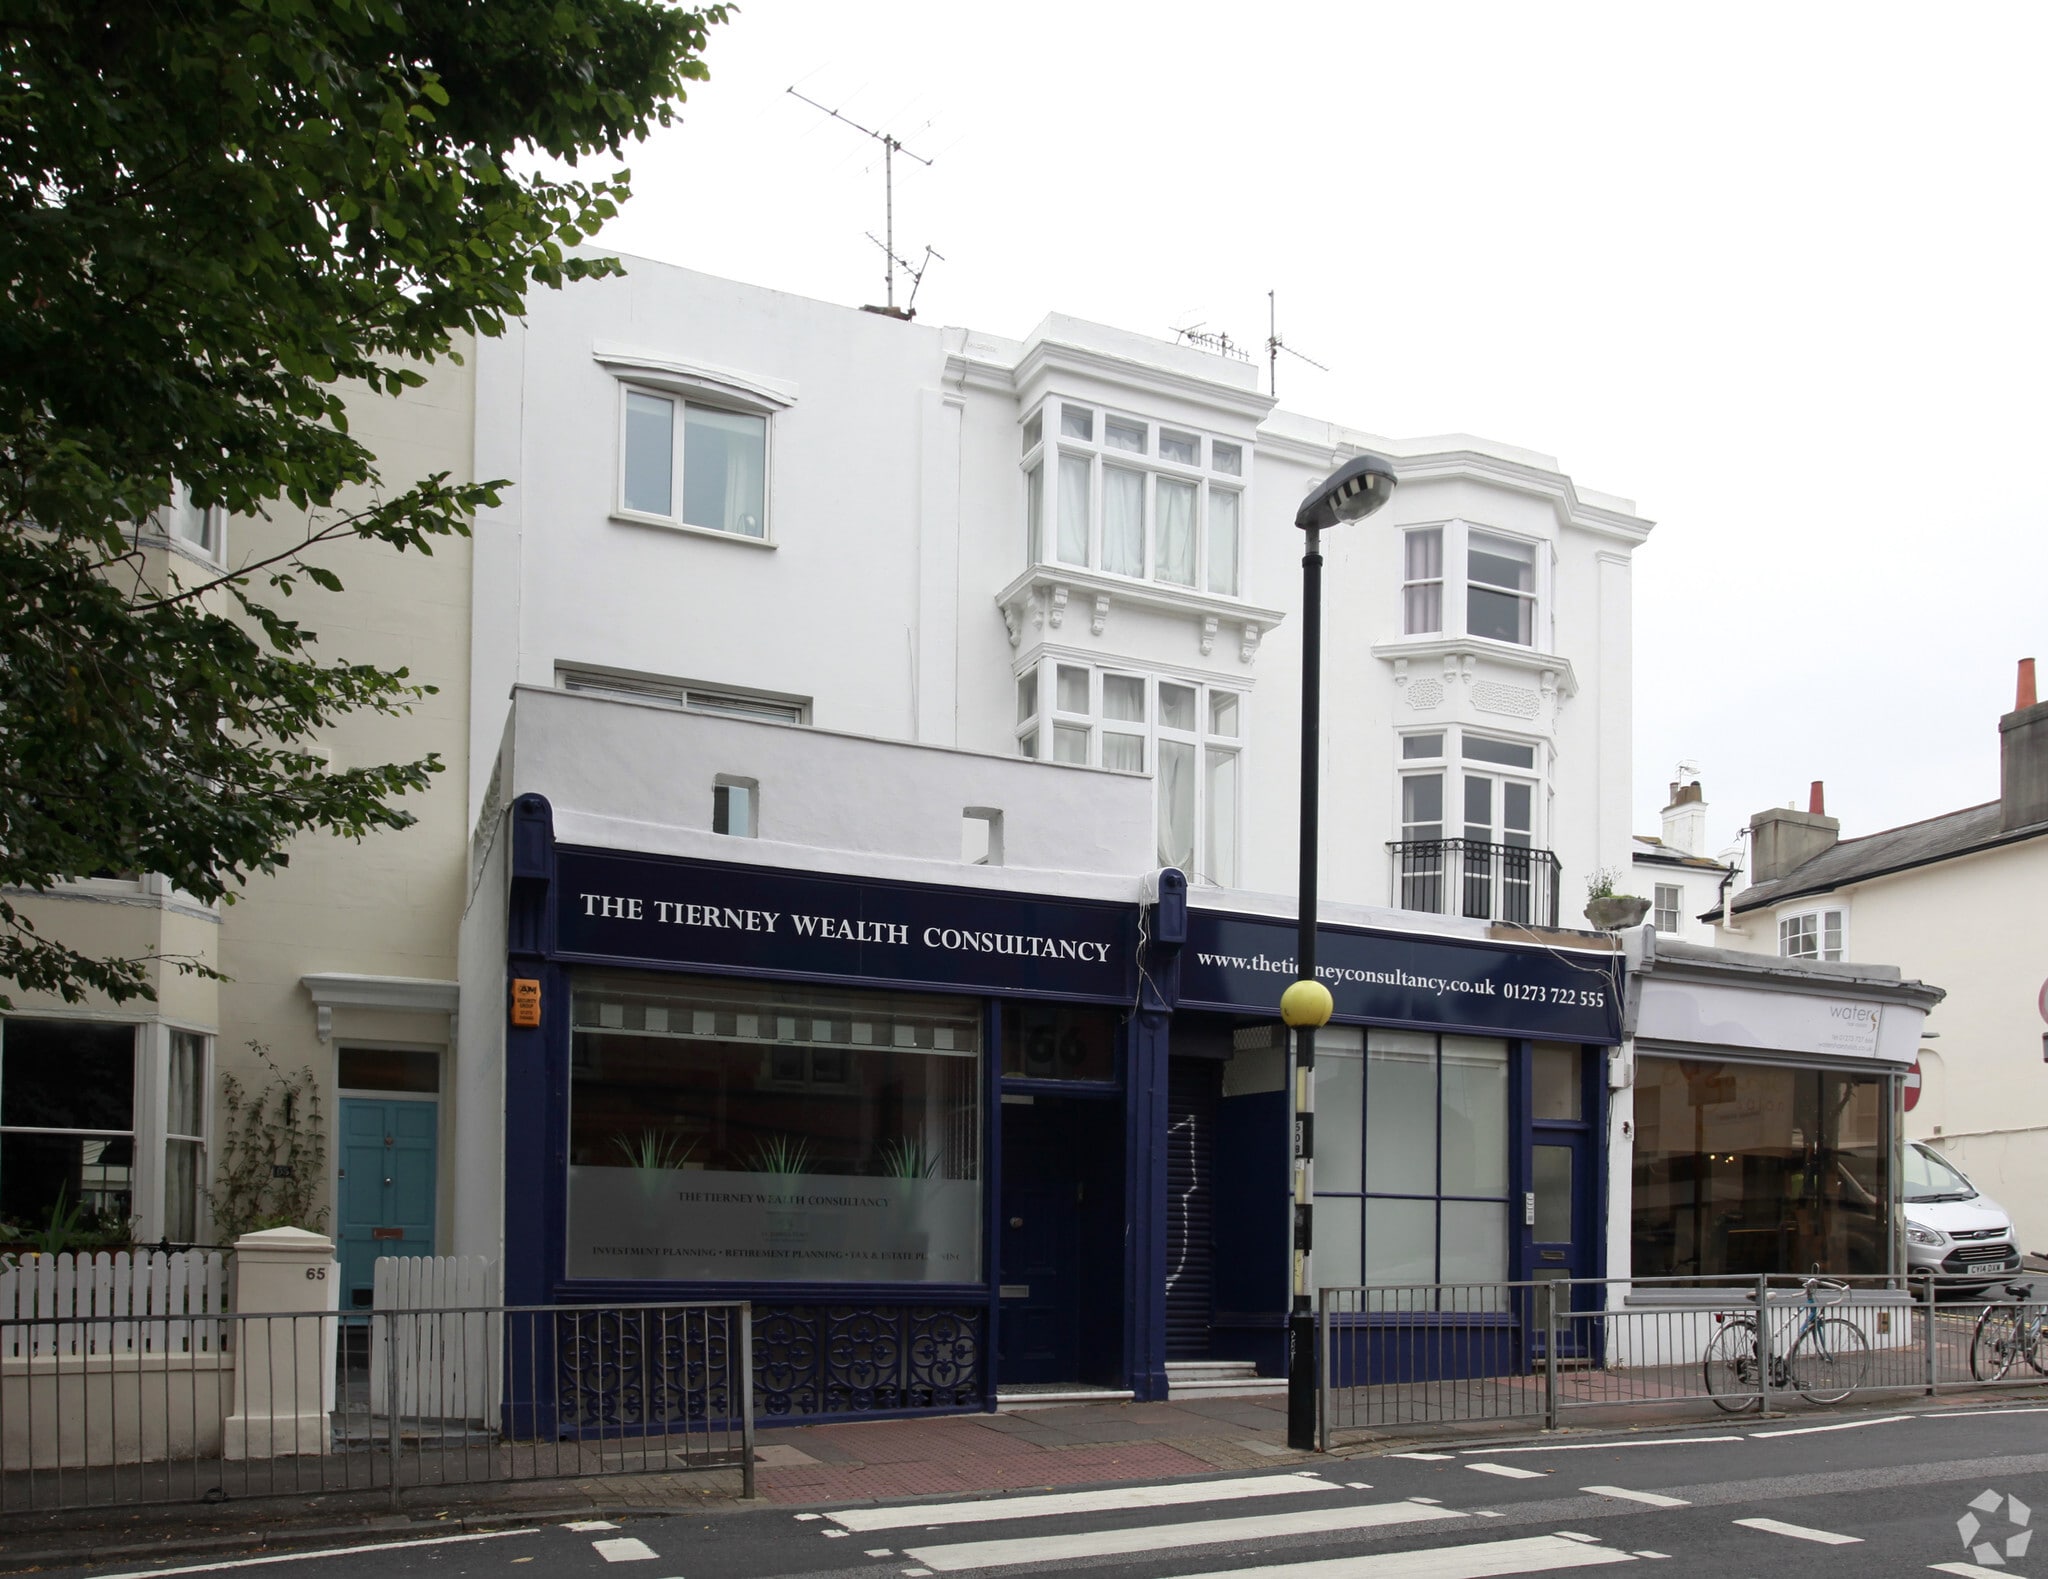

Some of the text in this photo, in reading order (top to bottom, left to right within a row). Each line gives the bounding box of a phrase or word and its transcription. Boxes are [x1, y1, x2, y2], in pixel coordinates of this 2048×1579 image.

[580, 893, 1111, 962] THE TIERNEY WEALTH CONSULTANCY
[1197, 953, 1605, 1008] www.thetineyconsultancy.co.uk 01273 722 555
[678, 1192, 704, 1202] THE
[704, 1193, 754, 1204] TIERNEY
[808, 1195, 890, 1208] CONSULTANCY
[592, 1246, 659, 1256] INVESTMENT
[663, 1247, 717, 1257] PLANNING
[725, 1248, 788, 1259] RETIREMENT
[792, 1250, 842, 1260] PLANNING
[306, 1267, 326, 1280] 65
